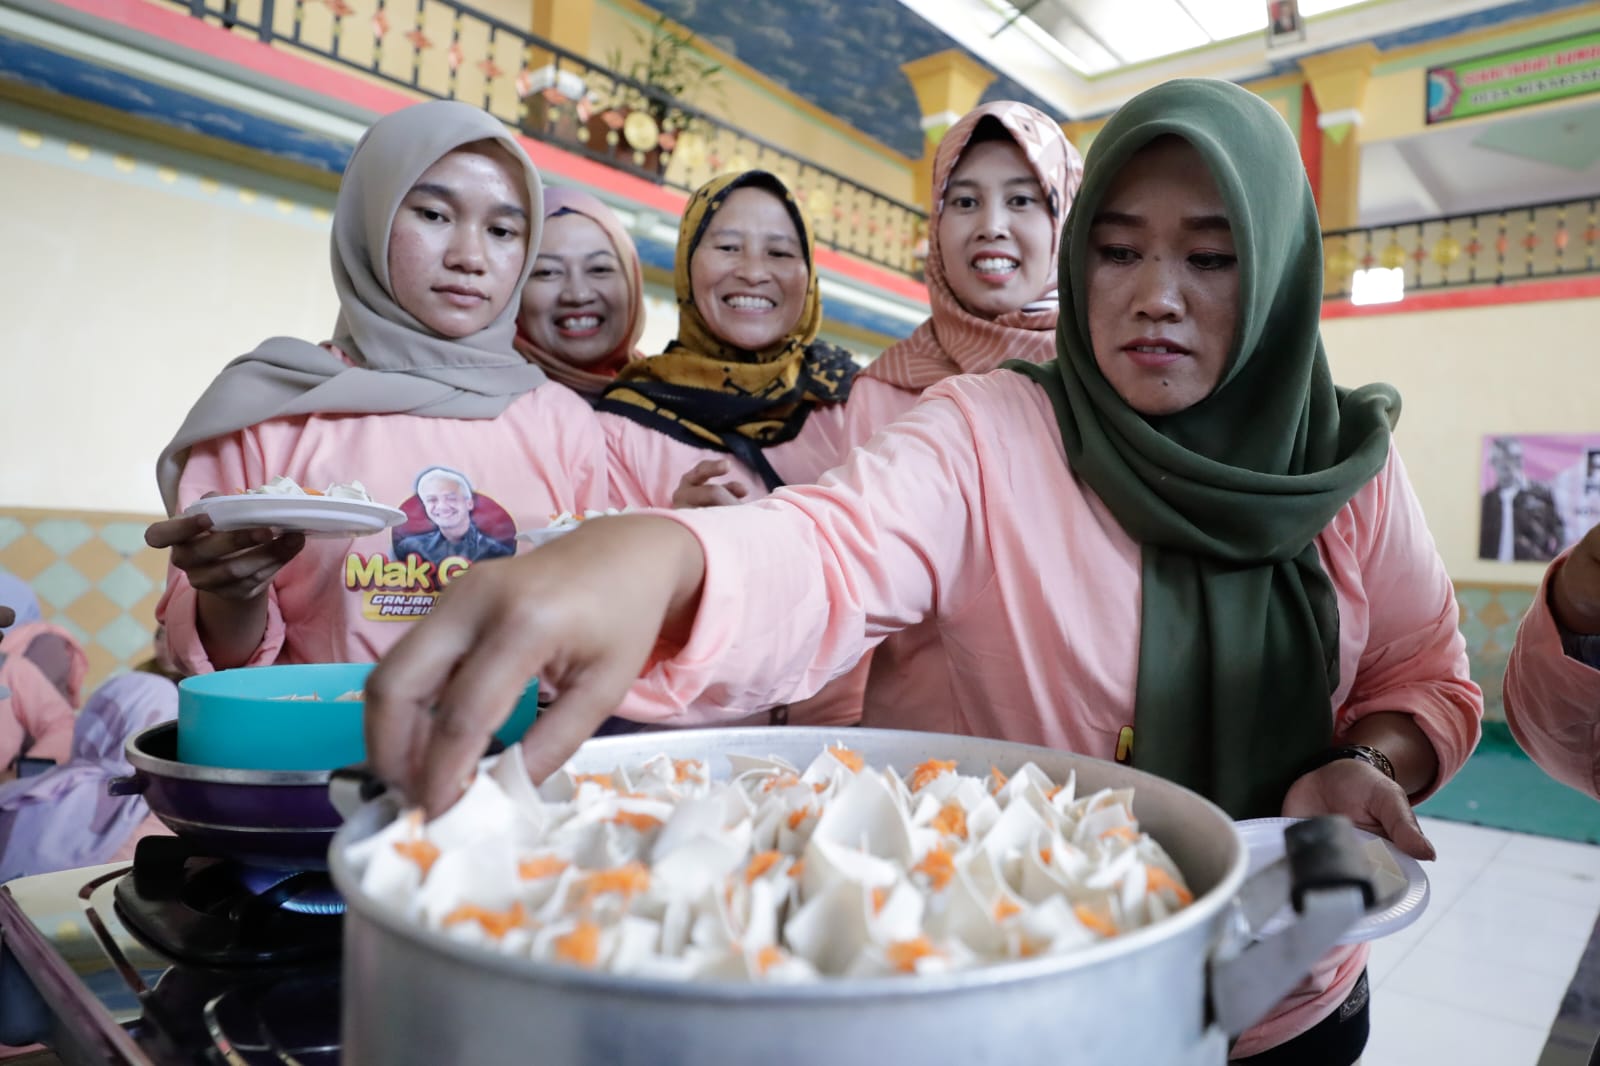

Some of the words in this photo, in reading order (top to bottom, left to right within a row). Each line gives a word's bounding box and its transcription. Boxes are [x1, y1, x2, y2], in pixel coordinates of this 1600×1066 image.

[345, 552, 433, 590] Mak
[371, 594, 434, 605] GANJAR
[380, 604, 433, 615] PRESI
